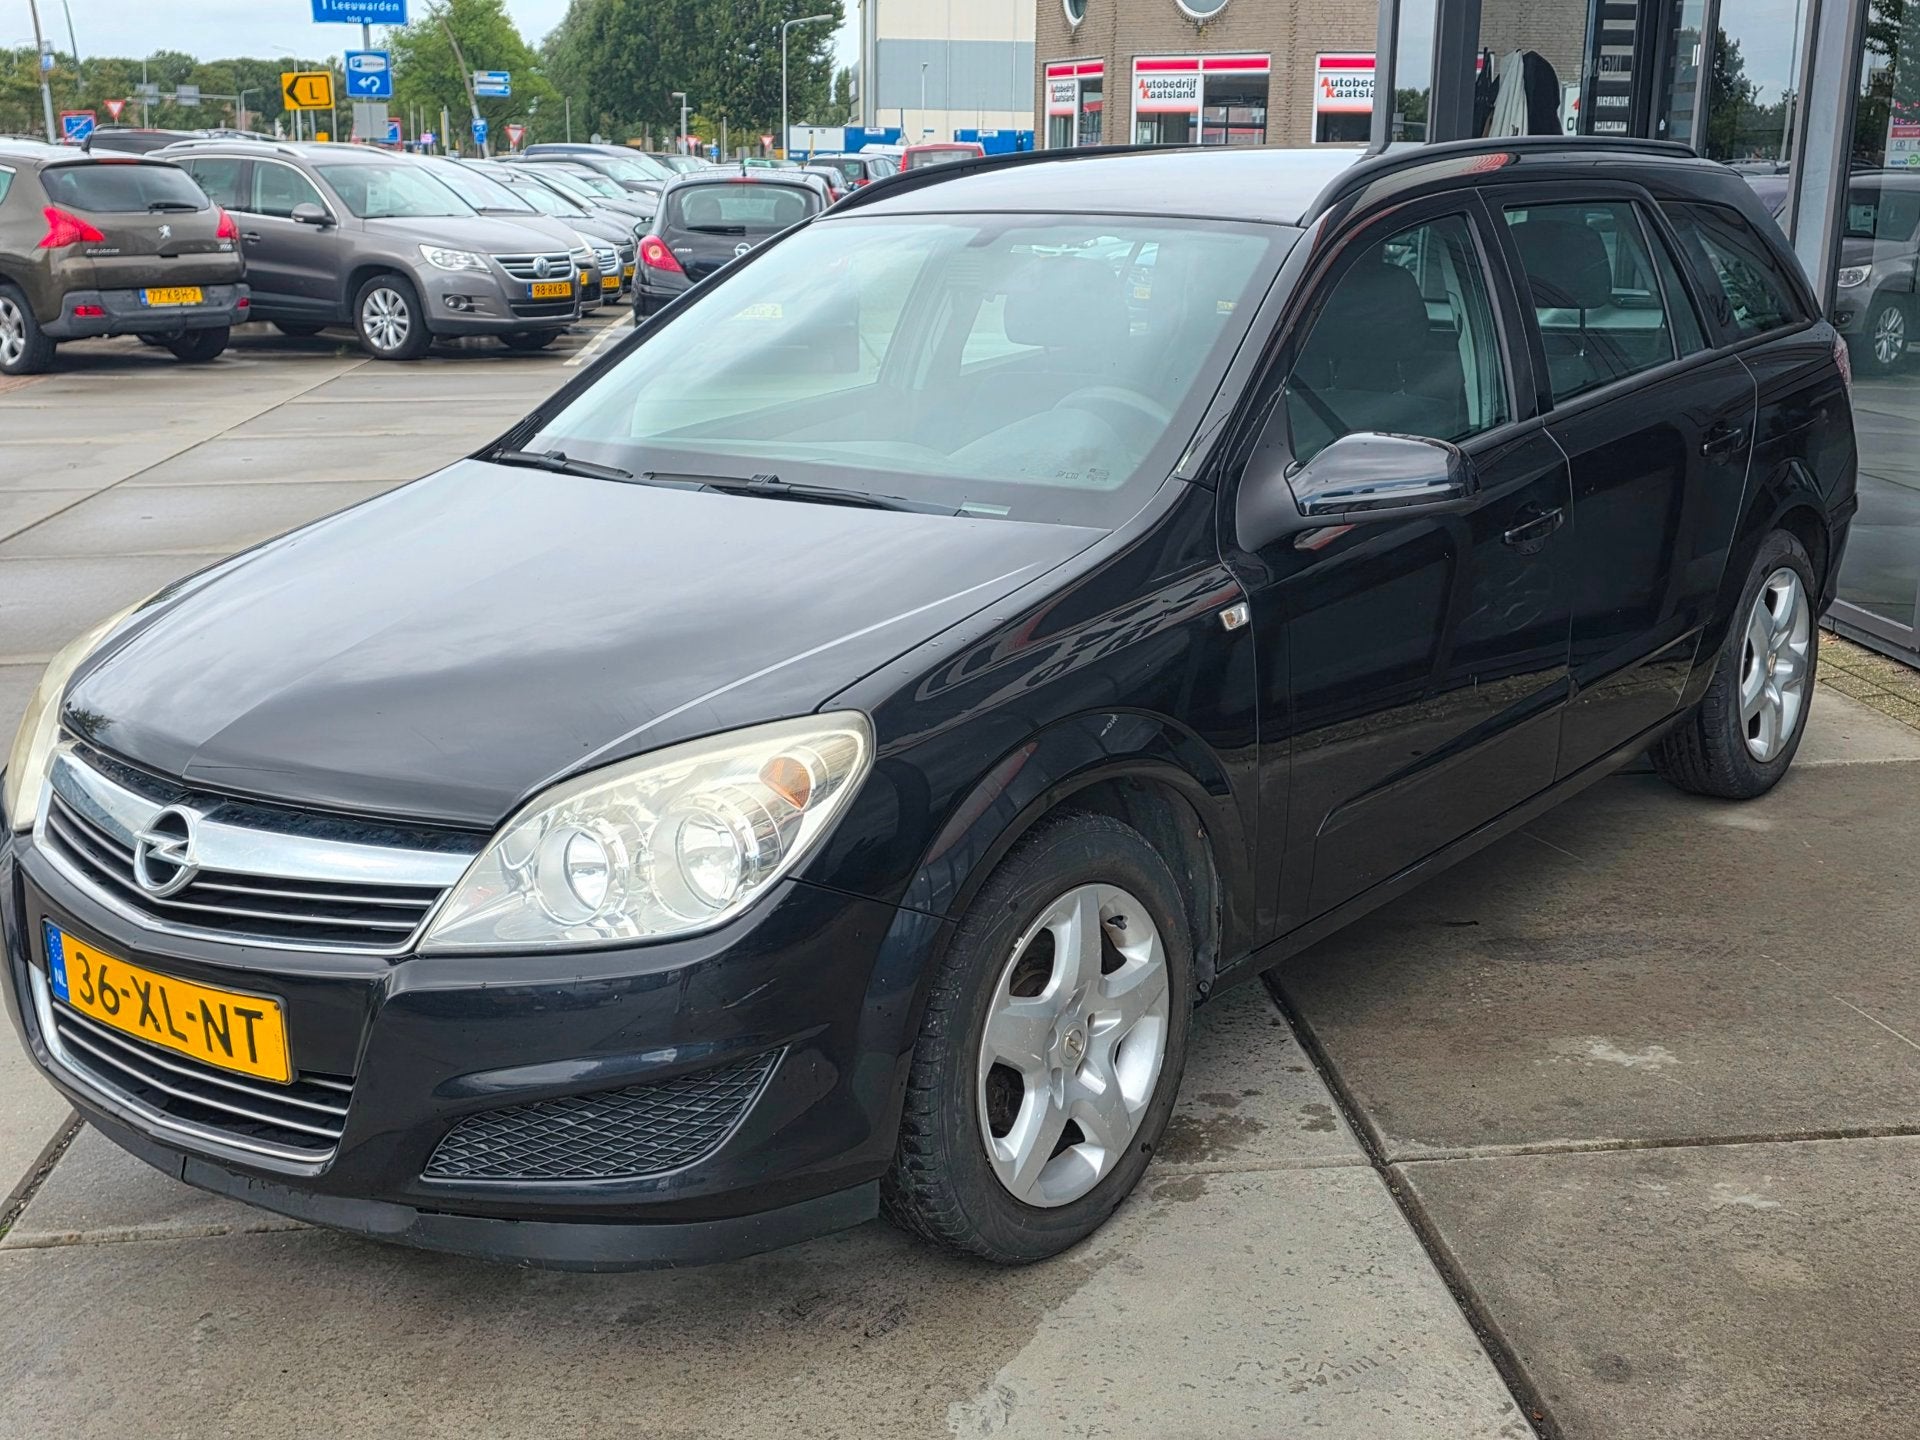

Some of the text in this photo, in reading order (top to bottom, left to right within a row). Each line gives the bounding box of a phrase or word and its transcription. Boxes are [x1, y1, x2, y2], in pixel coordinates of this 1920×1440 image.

[331, 0, 400, 11] Leeuwarden
[309, 82, 319, 100] L
[1139, 78, 1197, 90] Autobedrijf
[1142, 88, 1196, 99] Kaatsland
[54, 966, 68, 988] NL
[75, 951, 264, 1064] 36-XL-NT
